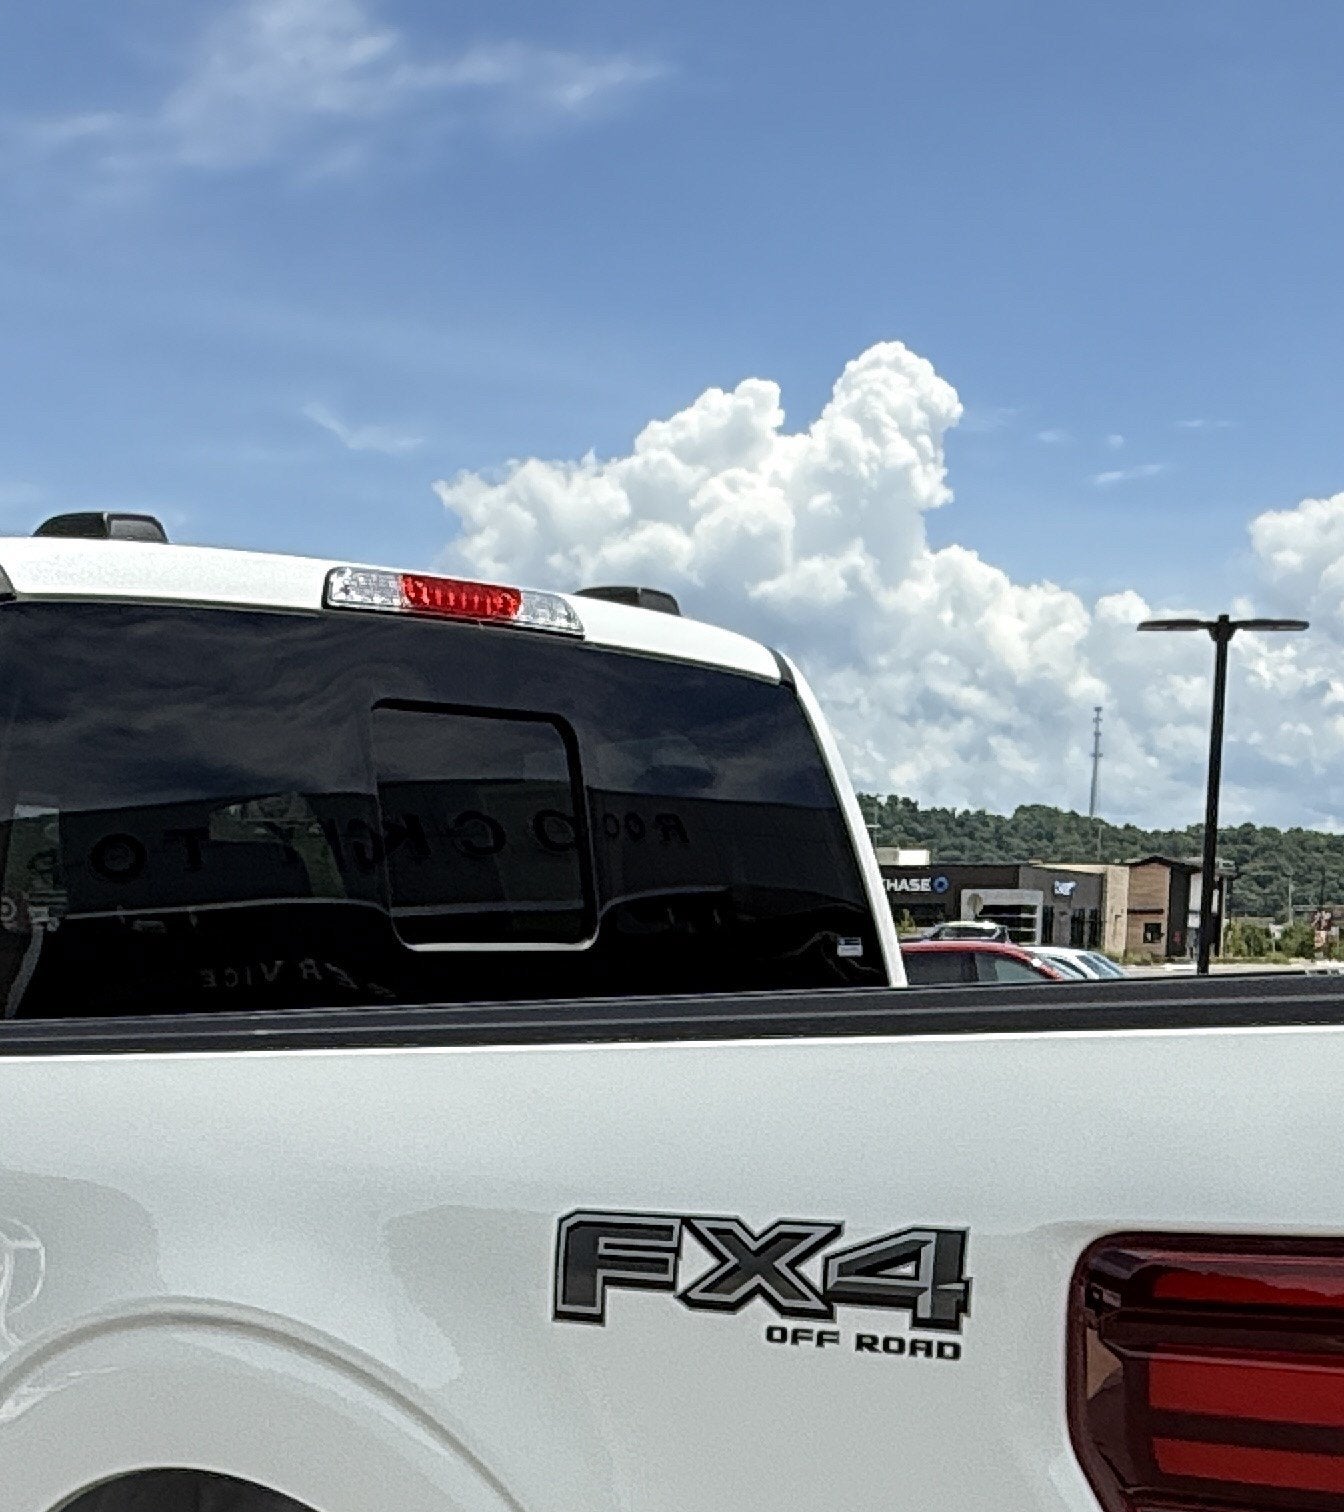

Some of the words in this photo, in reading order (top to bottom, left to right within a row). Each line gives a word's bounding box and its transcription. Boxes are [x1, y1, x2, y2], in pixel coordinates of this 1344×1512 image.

[882, 876, 931, 892] HASE
[553, 1209, 973, 1334] FX4
[765, 1325, 841, 1348] OFF
[855, 1332, 962, 1361] ROAD
